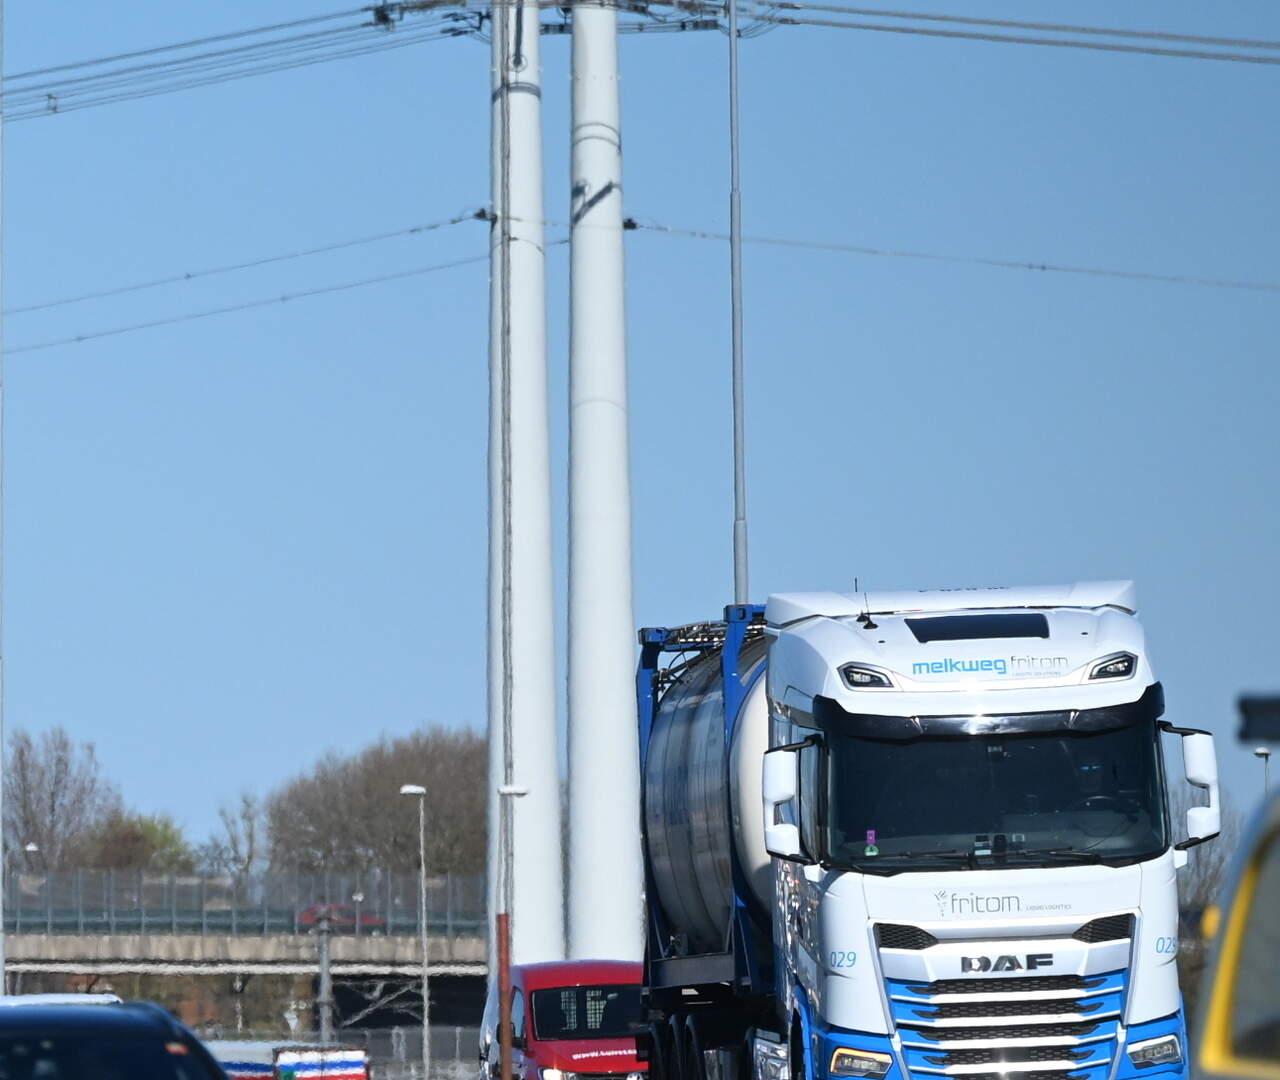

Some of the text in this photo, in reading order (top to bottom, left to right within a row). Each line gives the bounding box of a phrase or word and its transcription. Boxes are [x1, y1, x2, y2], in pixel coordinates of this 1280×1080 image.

[912, 658, 1007, 674] melkweg
[1011, 655, 1068, 669] fritom
[952, 893, 1020, 913] fritom
[831, 951, 856, 967] 029
[961, 953, 1053, 973] DAF
